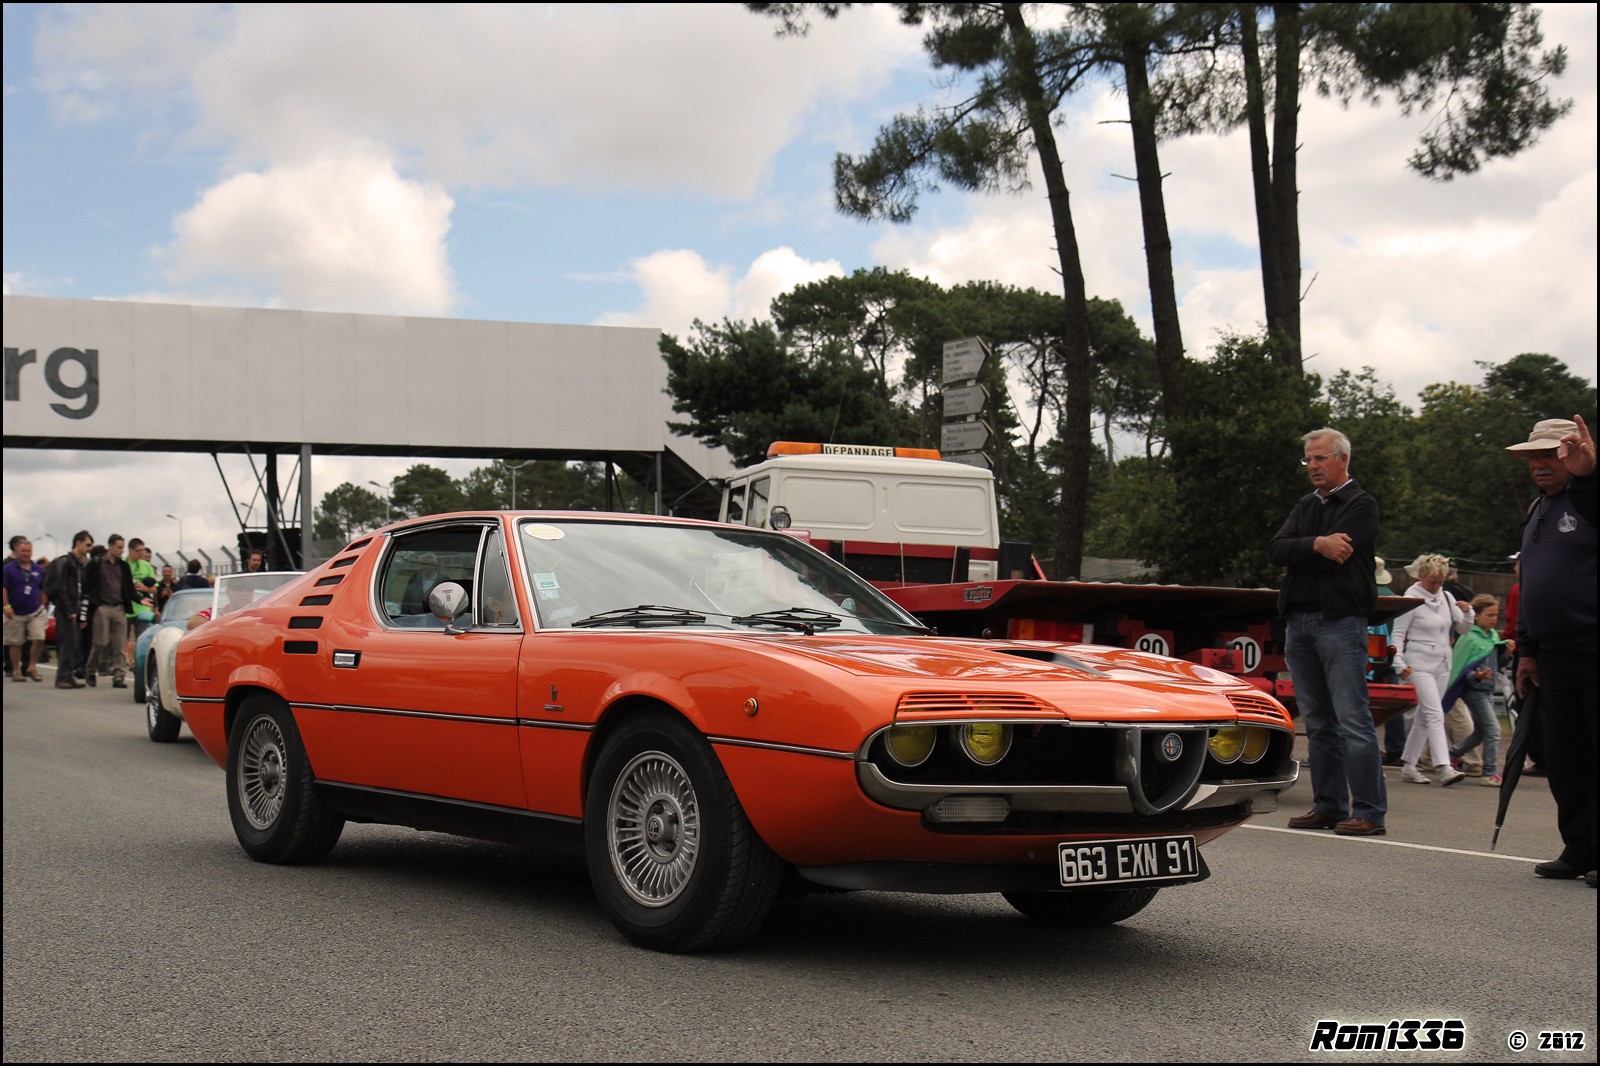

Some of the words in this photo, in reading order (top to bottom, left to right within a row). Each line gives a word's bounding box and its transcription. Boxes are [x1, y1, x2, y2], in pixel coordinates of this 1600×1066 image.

[825, 446, 892, 457] DEPANNAGE
[1061, 846, 1108, 883] 663
[1116, 842, 1159, 878] EXN
[1166, 840, 1193, 874] 91
